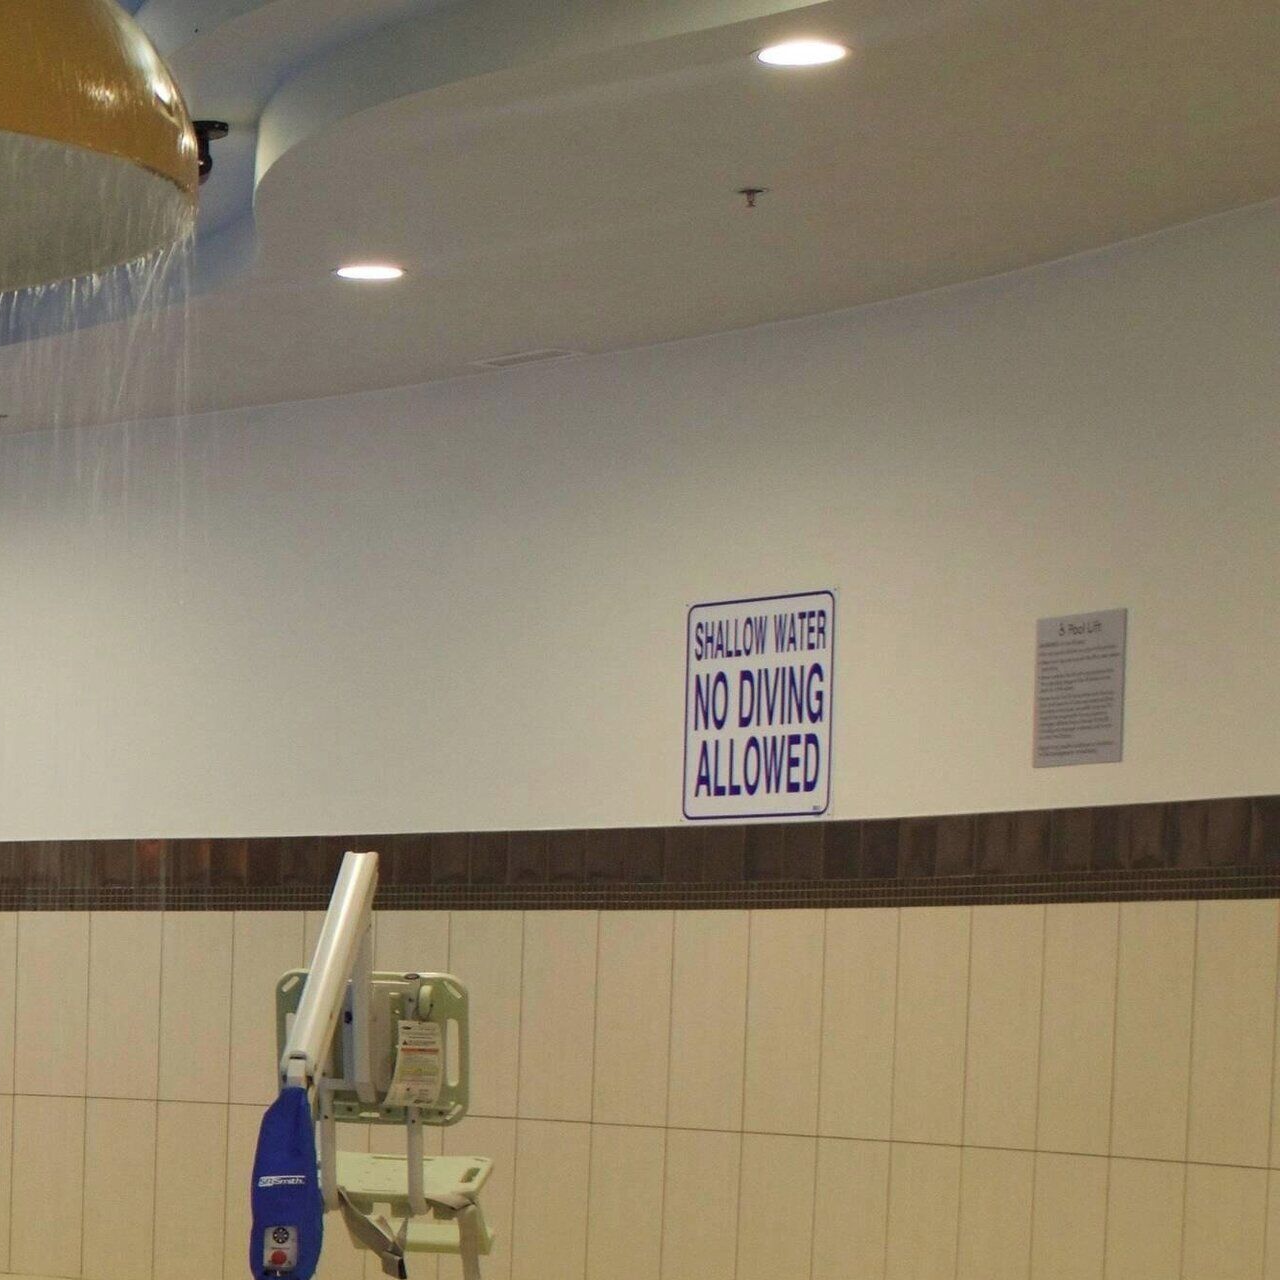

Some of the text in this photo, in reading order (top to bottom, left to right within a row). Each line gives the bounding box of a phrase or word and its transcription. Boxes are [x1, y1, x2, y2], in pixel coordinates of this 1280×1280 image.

[694, 609, 827, 661] SHALLOW WATER
[694, 662, 824, 731] NO DIVING
[694, 733, 820, 797] ALLOWED
